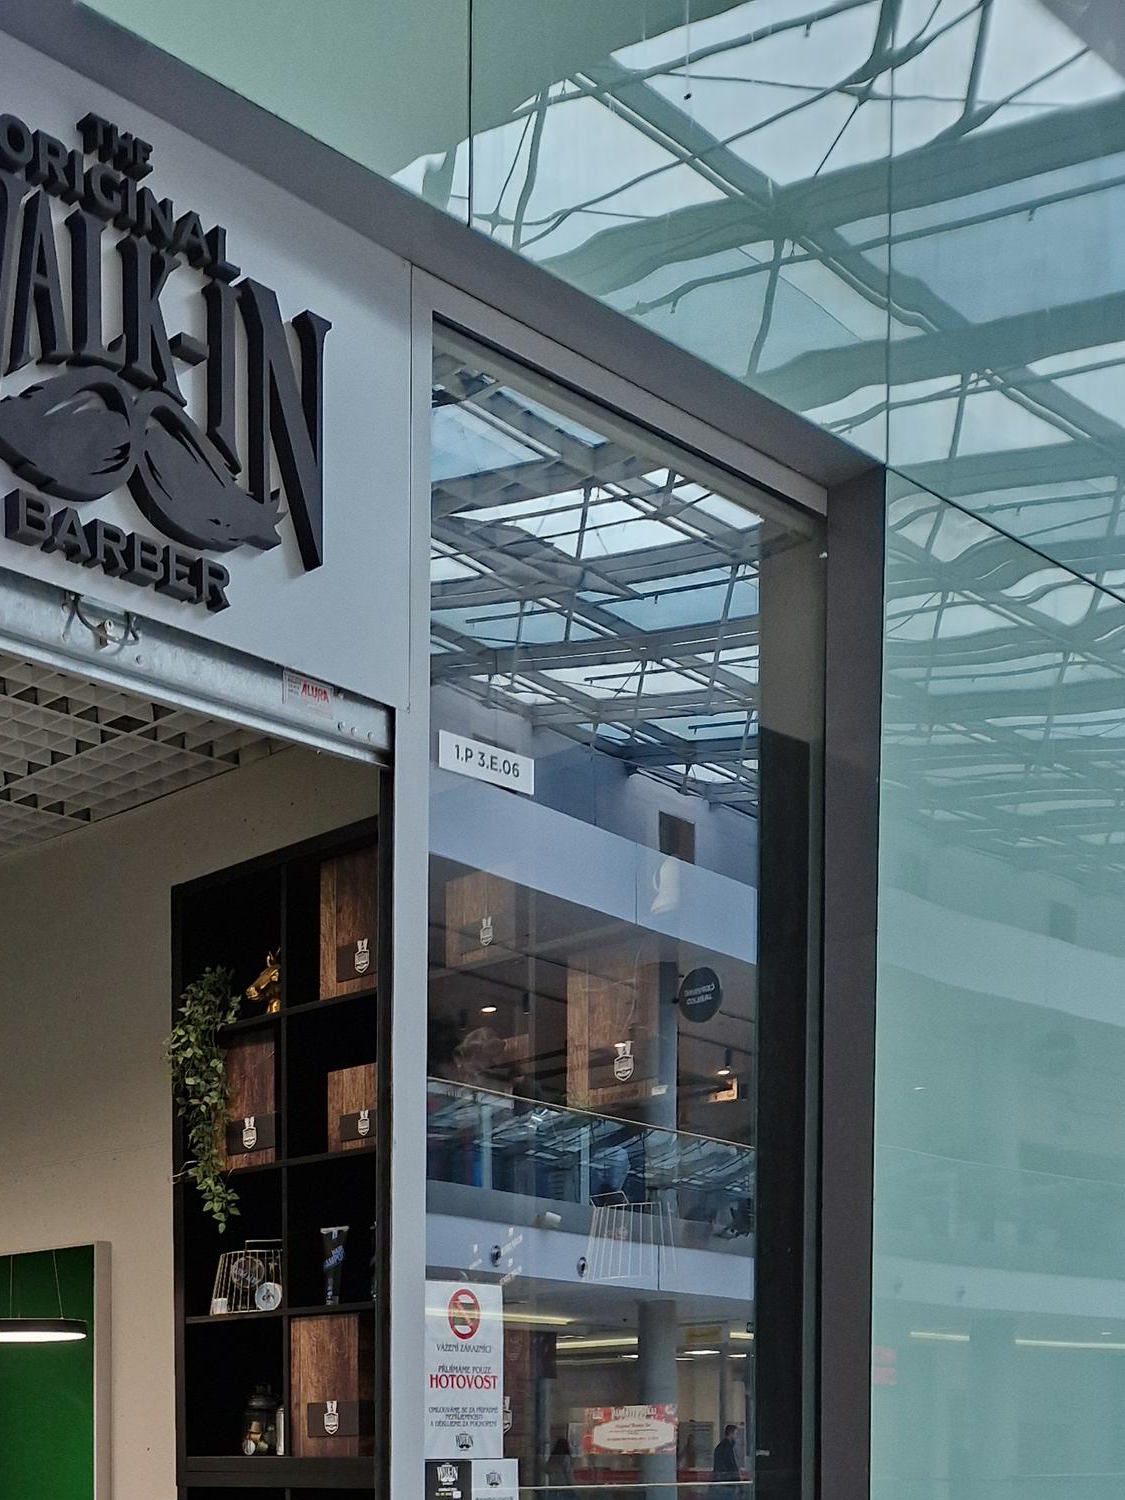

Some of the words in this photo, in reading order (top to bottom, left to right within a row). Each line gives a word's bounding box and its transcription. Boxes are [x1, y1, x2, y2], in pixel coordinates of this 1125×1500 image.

[77, 112, 153, 180] THE
[4, 487, 231, 613] BARBER
[454, 744, 474, 762] 1.P
[477, 752, 521, 778] 3.E.06
[429, 1374, 498, 1389] HOTOVOST
